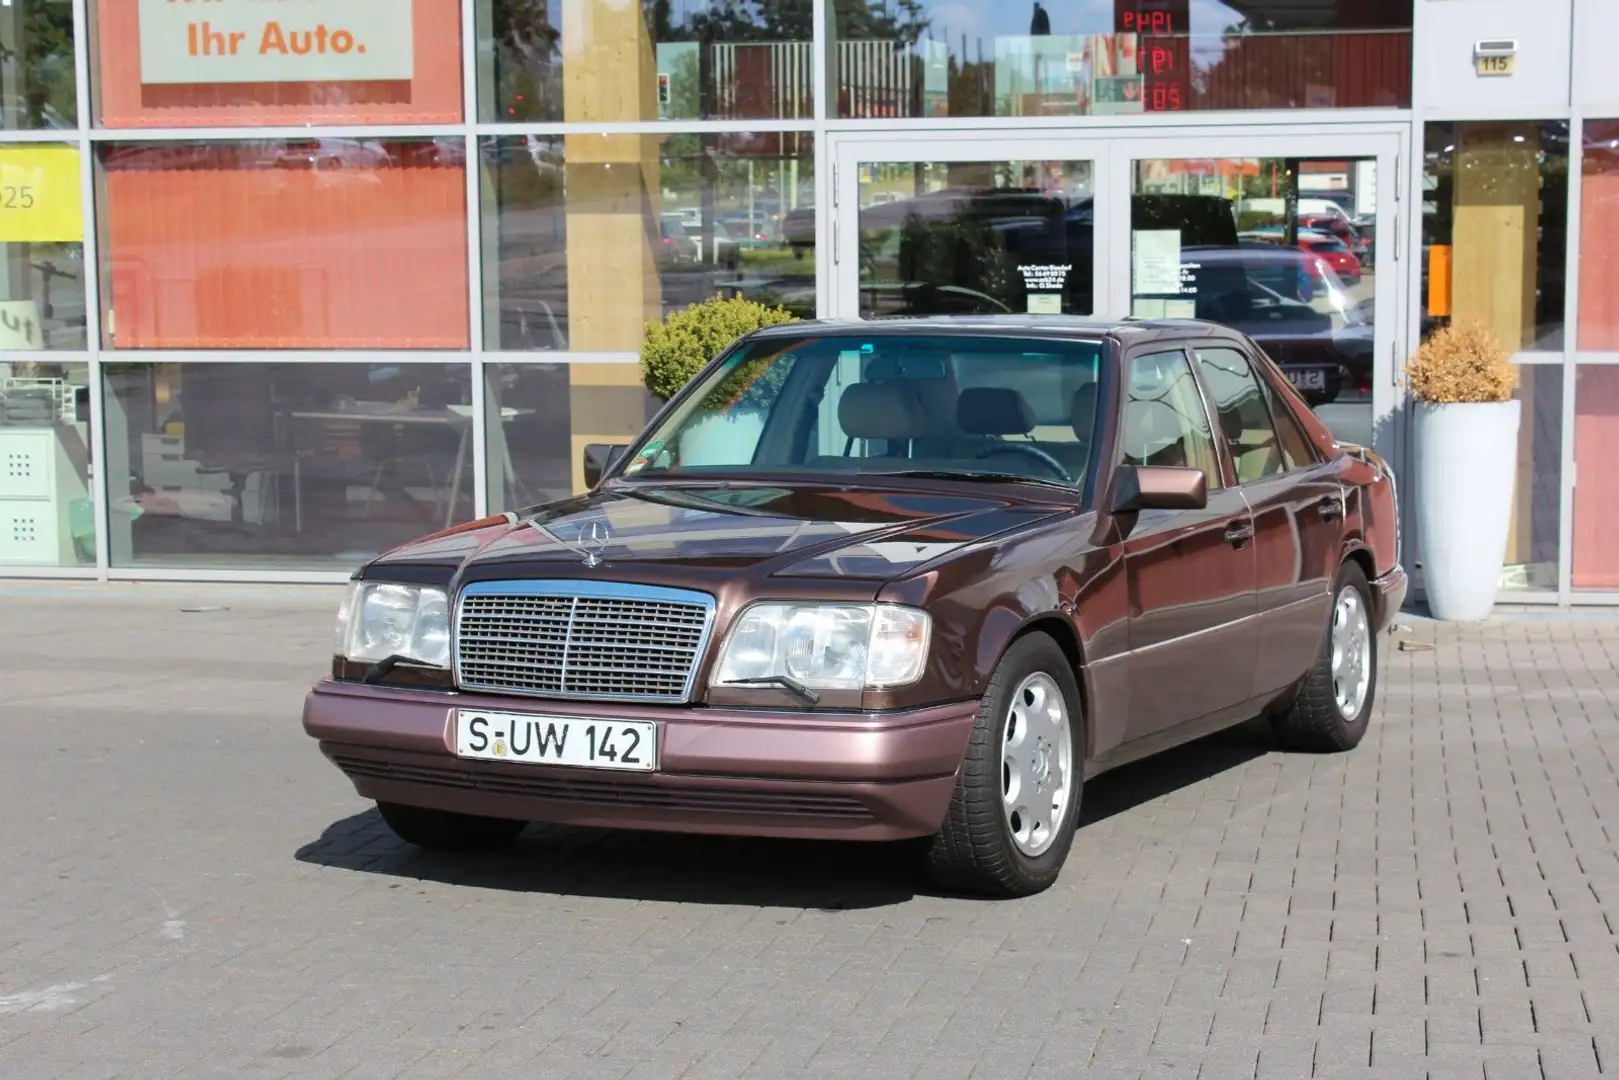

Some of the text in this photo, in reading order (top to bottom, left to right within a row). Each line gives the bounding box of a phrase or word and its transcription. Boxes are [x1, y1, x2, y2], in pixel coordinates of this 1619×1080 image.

[187, 21, 366, 56] Ihr Auto.
[1483, 56, 1507, 71] 115
[0, 186, 34, 209] 25
[469, 717, 640, 763] S-UW 142
